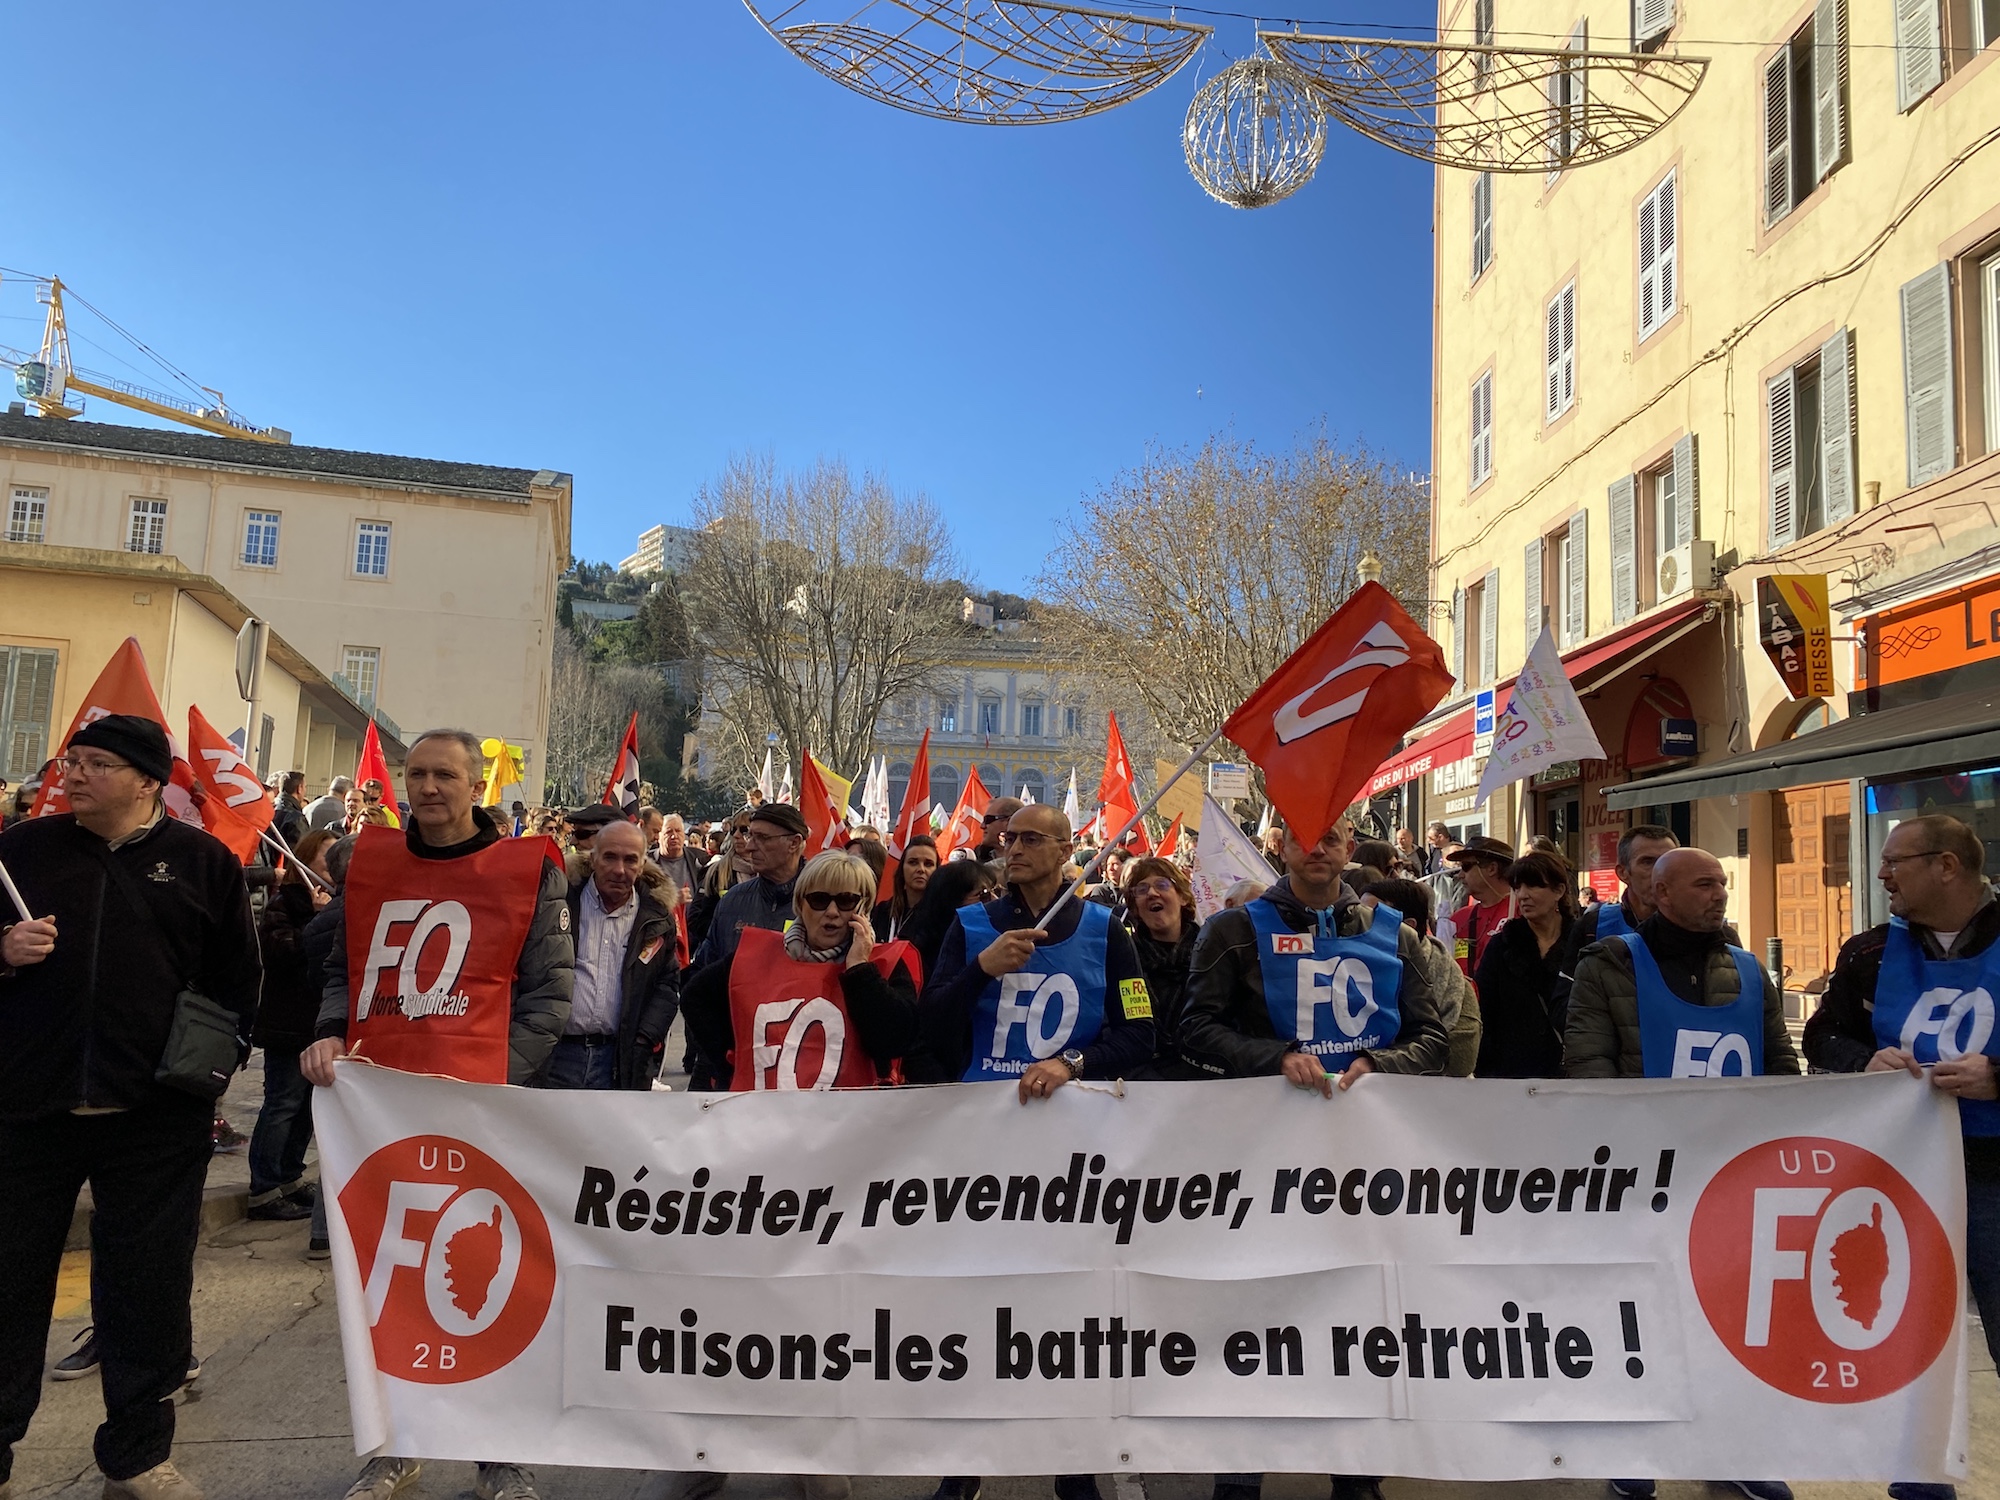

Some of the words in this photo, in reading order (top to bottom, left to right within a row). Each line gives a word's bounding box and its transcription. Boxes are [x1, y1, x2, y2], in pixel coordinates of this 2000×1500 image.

[1766, 602, 1799, 672] TABAC
[1810, 627, 1829, 692] PRESSE
[1372, 773, 1392, 791] CAFE
[1392, 768, 1404, 783] DU
[1405, 756, 1432, 779] LYCEE
[1586, 756, 1623, 783] CAFE
[357, 900, 472, 1022] FO
[1278, 936, 1304, 952] FO
[372, 990, 405, 1016] force
[405, 988, 470, 1021] syndicale
[991, 972, 1080, 1060] FO
[1296, 956, 1379, 1041] FO
[1900, 986, 1996, 1062] FO
[753, 996, 846, 1092] FO
[1300, 1034, 1380, 1056] énitentiair
[1671, 1029, 1753, 1078] FO
[418, 1145, 467, 1172] UD
[1778, 1149, 1837, 1175] UD
[575, 1165, 844, 1245] Résister,
[862, 1152, 1254, 1245] revendiquer,
[1271, 1145, 1639, 1236] reconquerir
[1651, 1149, 1676, 1213] !
[364, 1180, 523, 1337] FO
[1744, 1186, 1911, 1350] FO
[411, 1342, 458, 1370] 2B
[605, 1304, 969, 1382] Faisons-les
[995, 1306, 1197, 1380] battre
[1223, 1325, 1304, 1377] en
[1331, 1301, 1593, 1380] retraite
[1619, 1301, 1644, 1379] !
[1811, 1361, 1859, 1388] 2B
